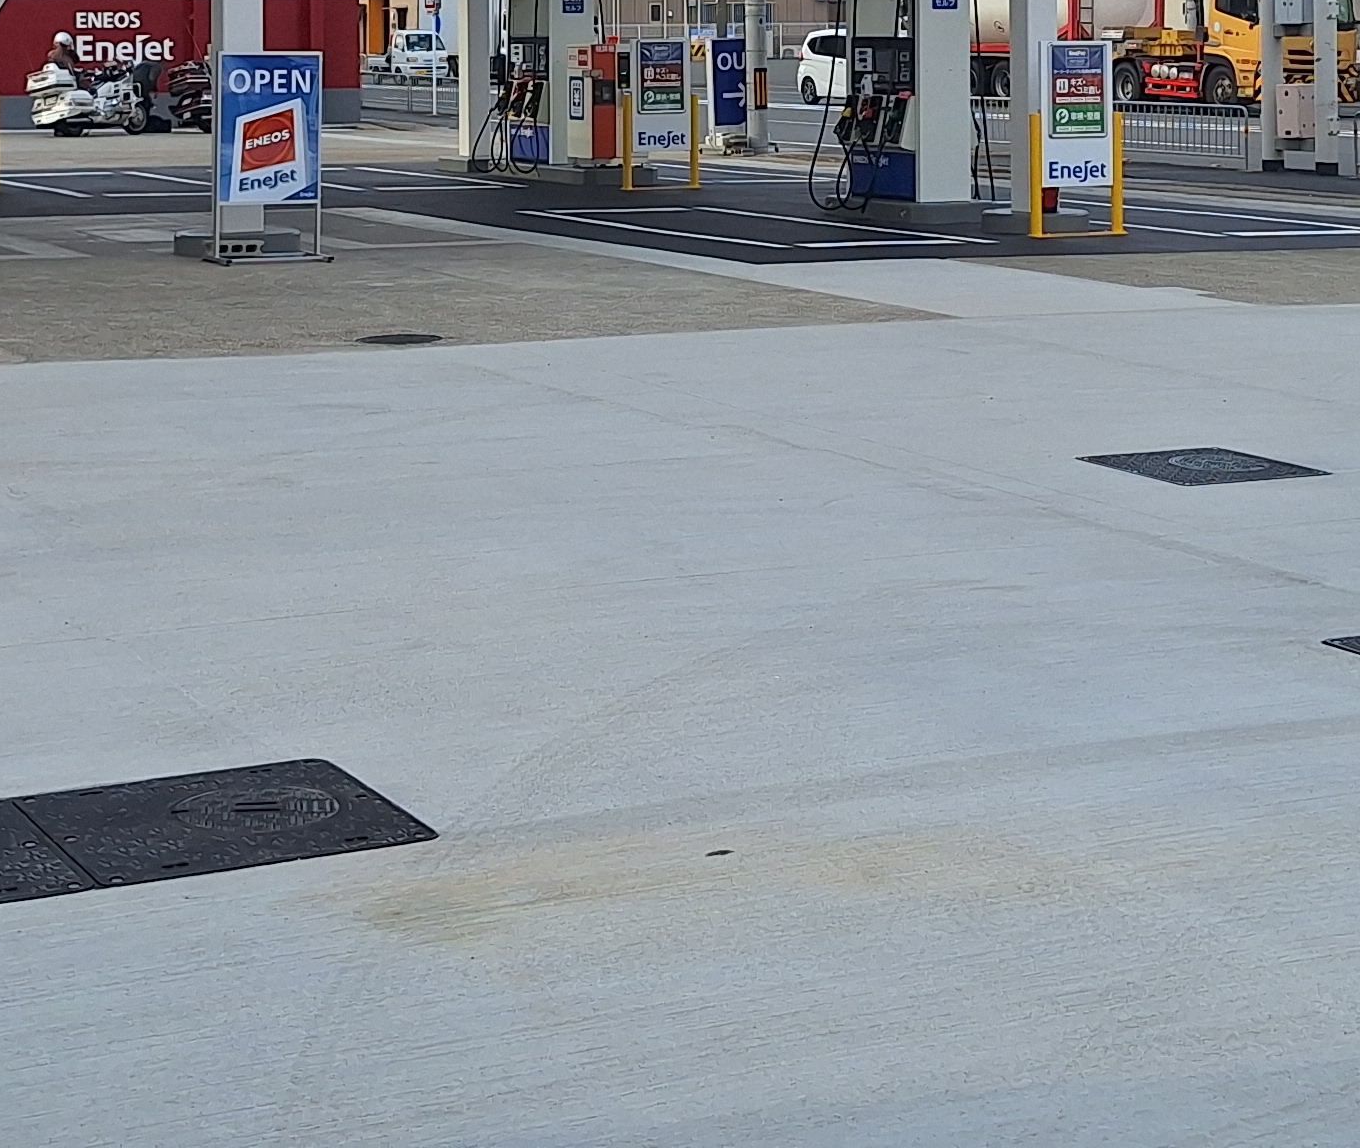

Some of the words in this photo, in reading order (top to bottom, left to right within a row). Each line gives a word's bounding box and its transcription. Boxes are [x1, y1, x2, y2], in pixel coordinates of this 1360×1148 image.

[935, 0, 956, 7] セルフ
[75, 12, 141, 29] ENEOS
[228, 68, 311, 94] OPEN
[244, 128, 291, 150] ENEOS
